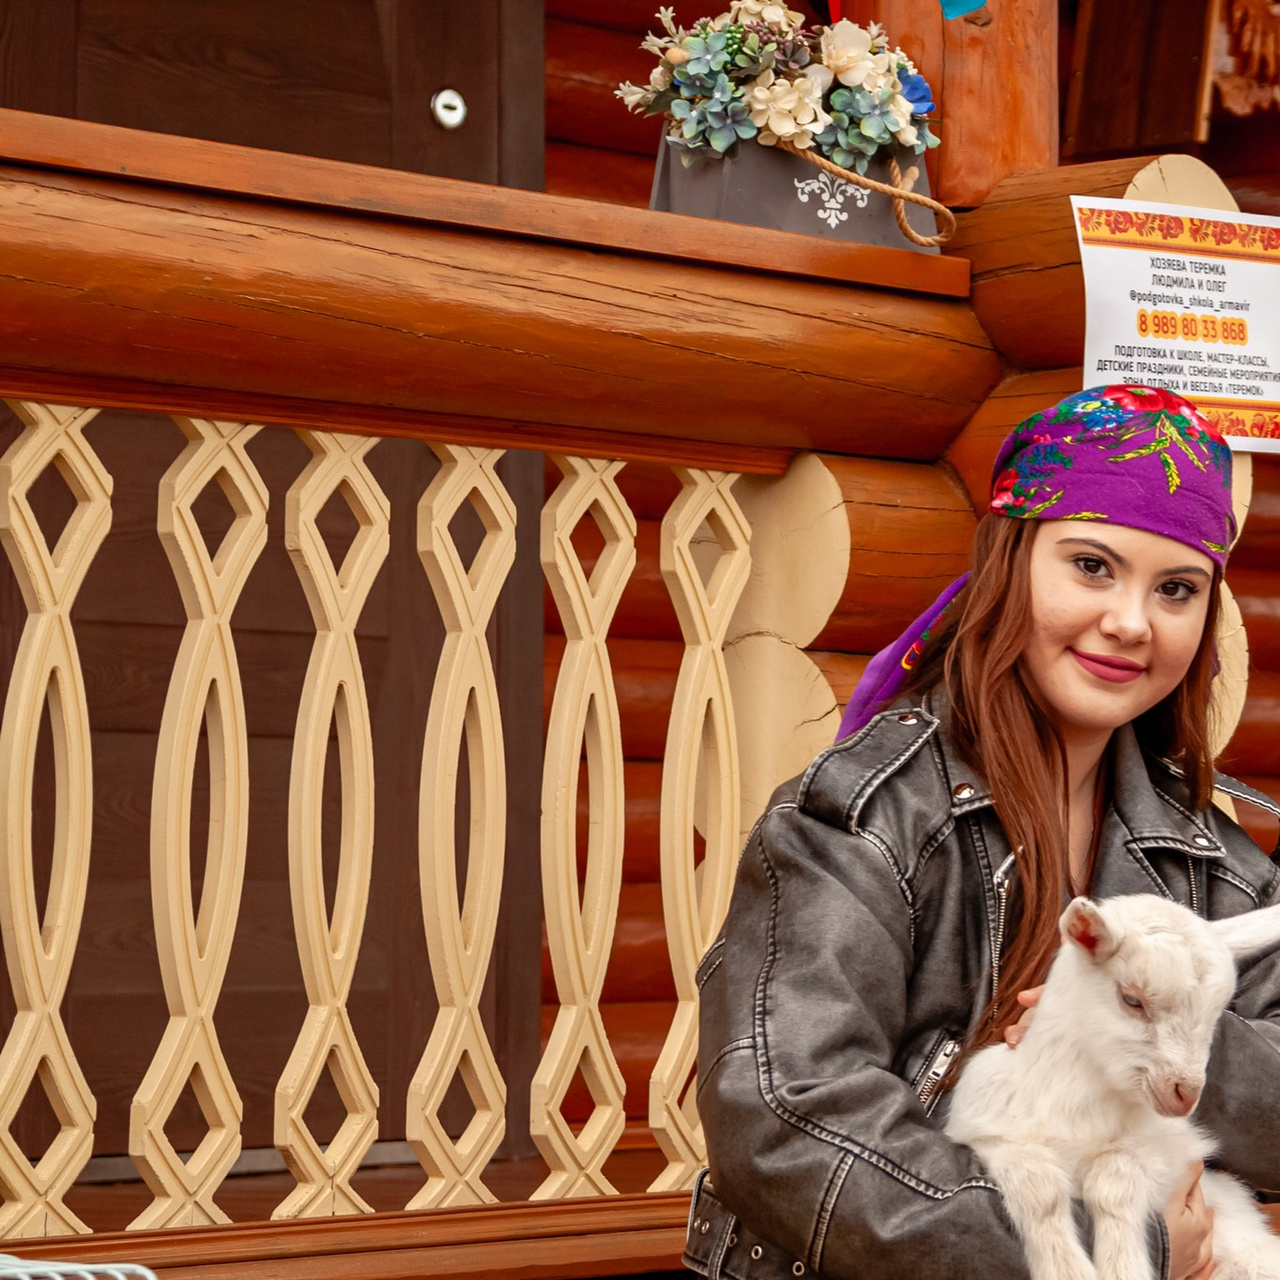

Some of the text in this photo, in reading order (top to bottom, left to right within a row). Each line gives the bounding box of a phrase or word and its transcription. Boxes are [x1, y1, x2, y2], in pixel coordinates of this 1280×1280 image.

[1150, 257, 1226, 276] ХОЗЯЕВА ТЕРЕМКА
[1152, 274, 1227, 292] ЛЮДМИЛА И ОЛЕГ
[1129, 289, 1250, 312] @podgotovka_shkola_armavir
[1139, 313, 1246, 341] 8 989 80 33 868
[1114, 345, 1269, 368] ПОДГОТОВКА К ШКОЛЕ, МАСТЕР-КЛАССЫ,
[1096, 359, 1134, 372] ДЕТСКИЕ
[1136, 362, 1186, 377] ПРАЗДНИКИ,
[1189, 365, 1228, 379] СЕМЕЙНЫЕ
[1147, 378, 1180, 391] ОТДЫХА
[1183, 381, 1188, 391] И
[1190, 381, 1223, 393] ВЕСЕЛЬЯ
[1225, 383, 1264, 396] «ТЕРЕМОК»
